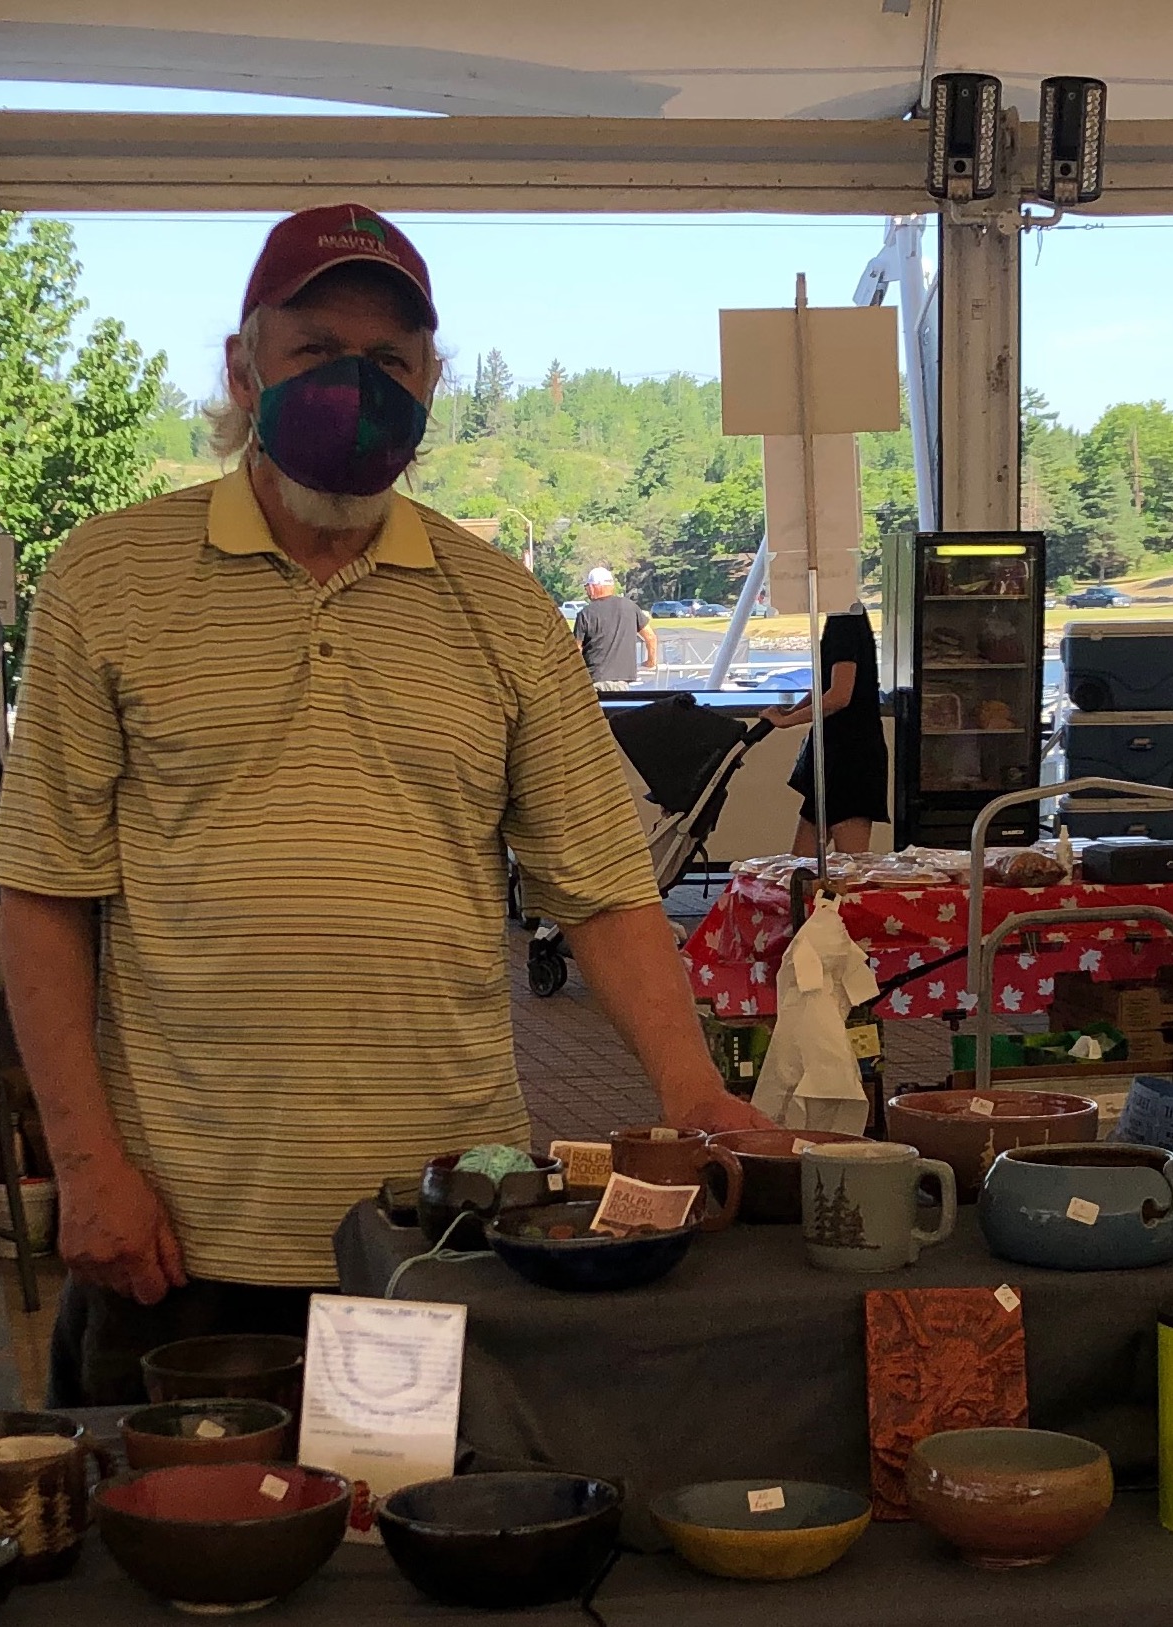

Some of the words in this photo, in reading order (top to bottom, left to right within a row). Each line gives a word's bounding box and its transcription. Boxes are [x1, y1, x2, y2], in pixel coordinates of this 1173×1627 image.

[572, 1151, 613, 1164] RALPH
[570, 1163, 613, 1175] ROGER
[613, 1190, 653, 1206] RALPH
[608, 1200, 656, 1220] ROGERS
